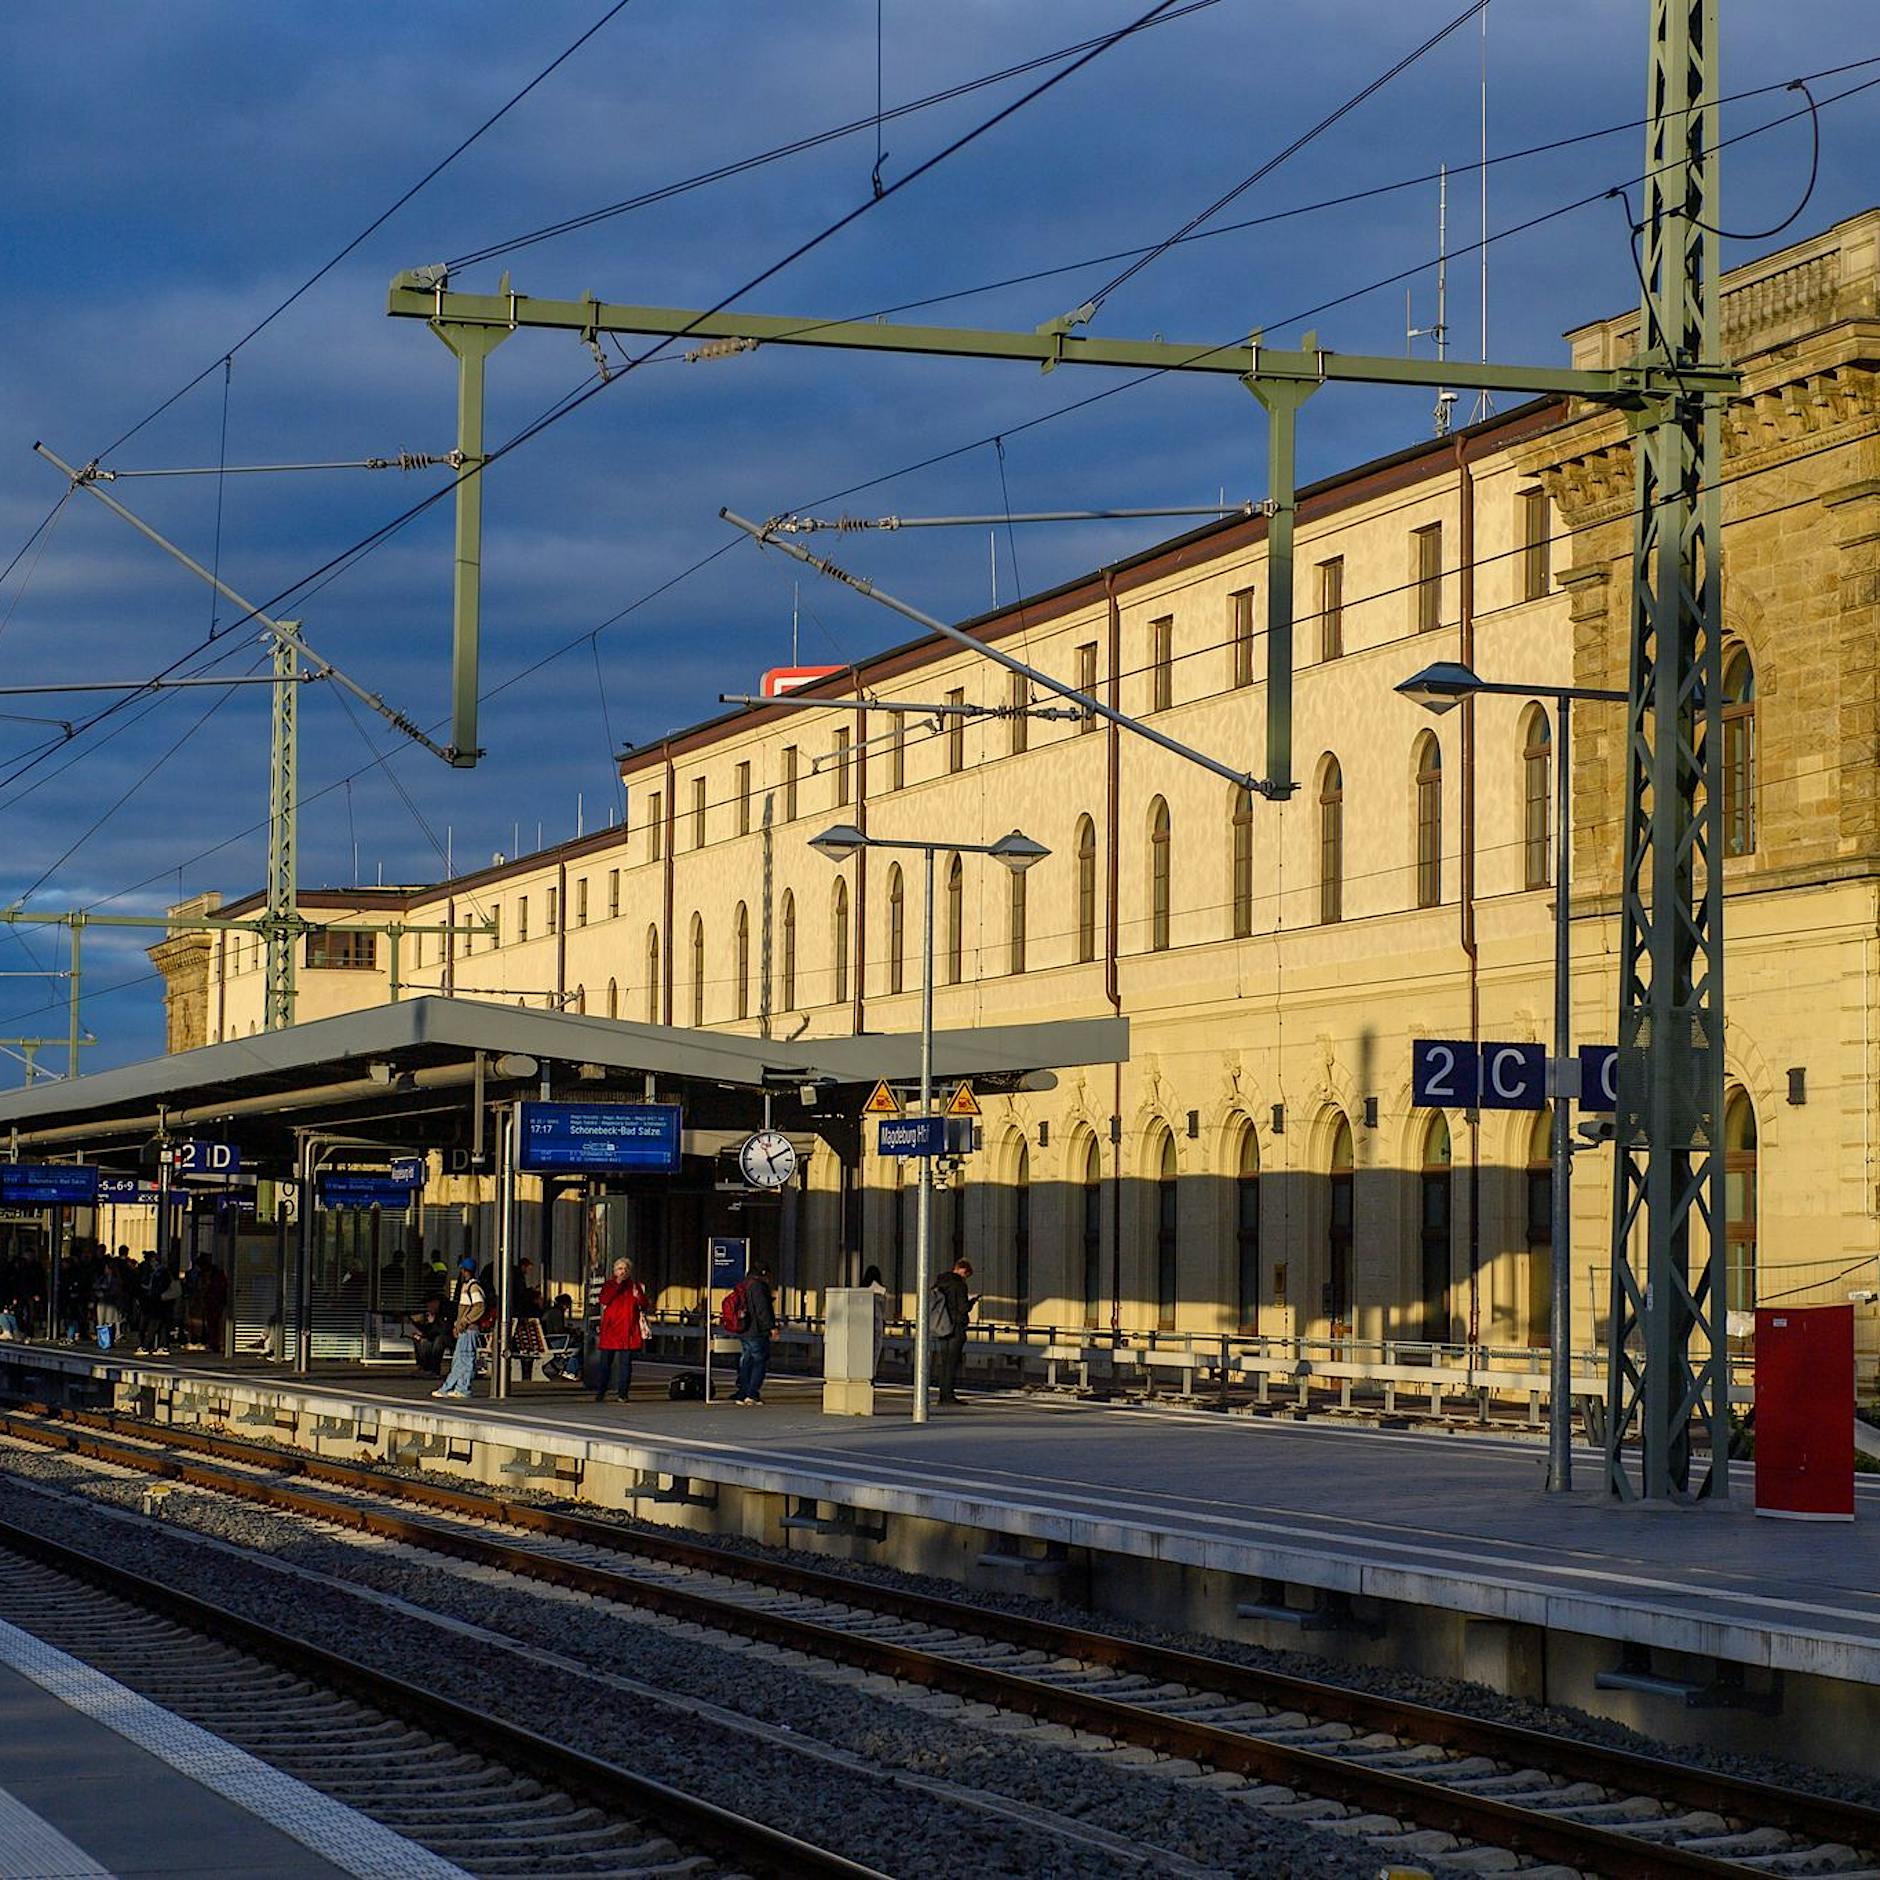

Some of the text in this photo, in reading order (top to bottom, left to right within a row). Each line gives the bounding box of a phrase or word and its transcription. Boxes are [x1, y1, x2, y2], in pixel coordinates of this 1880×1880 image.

[1424, 1045, 1527, 1099] 2 C
[530, 1124, 552, 1135] 17:17
[881, 1125, 917, 1150] Magdeburg
[181, 1143, 231, 1169] 2 D
[452, 1149, 469, 1170] D
